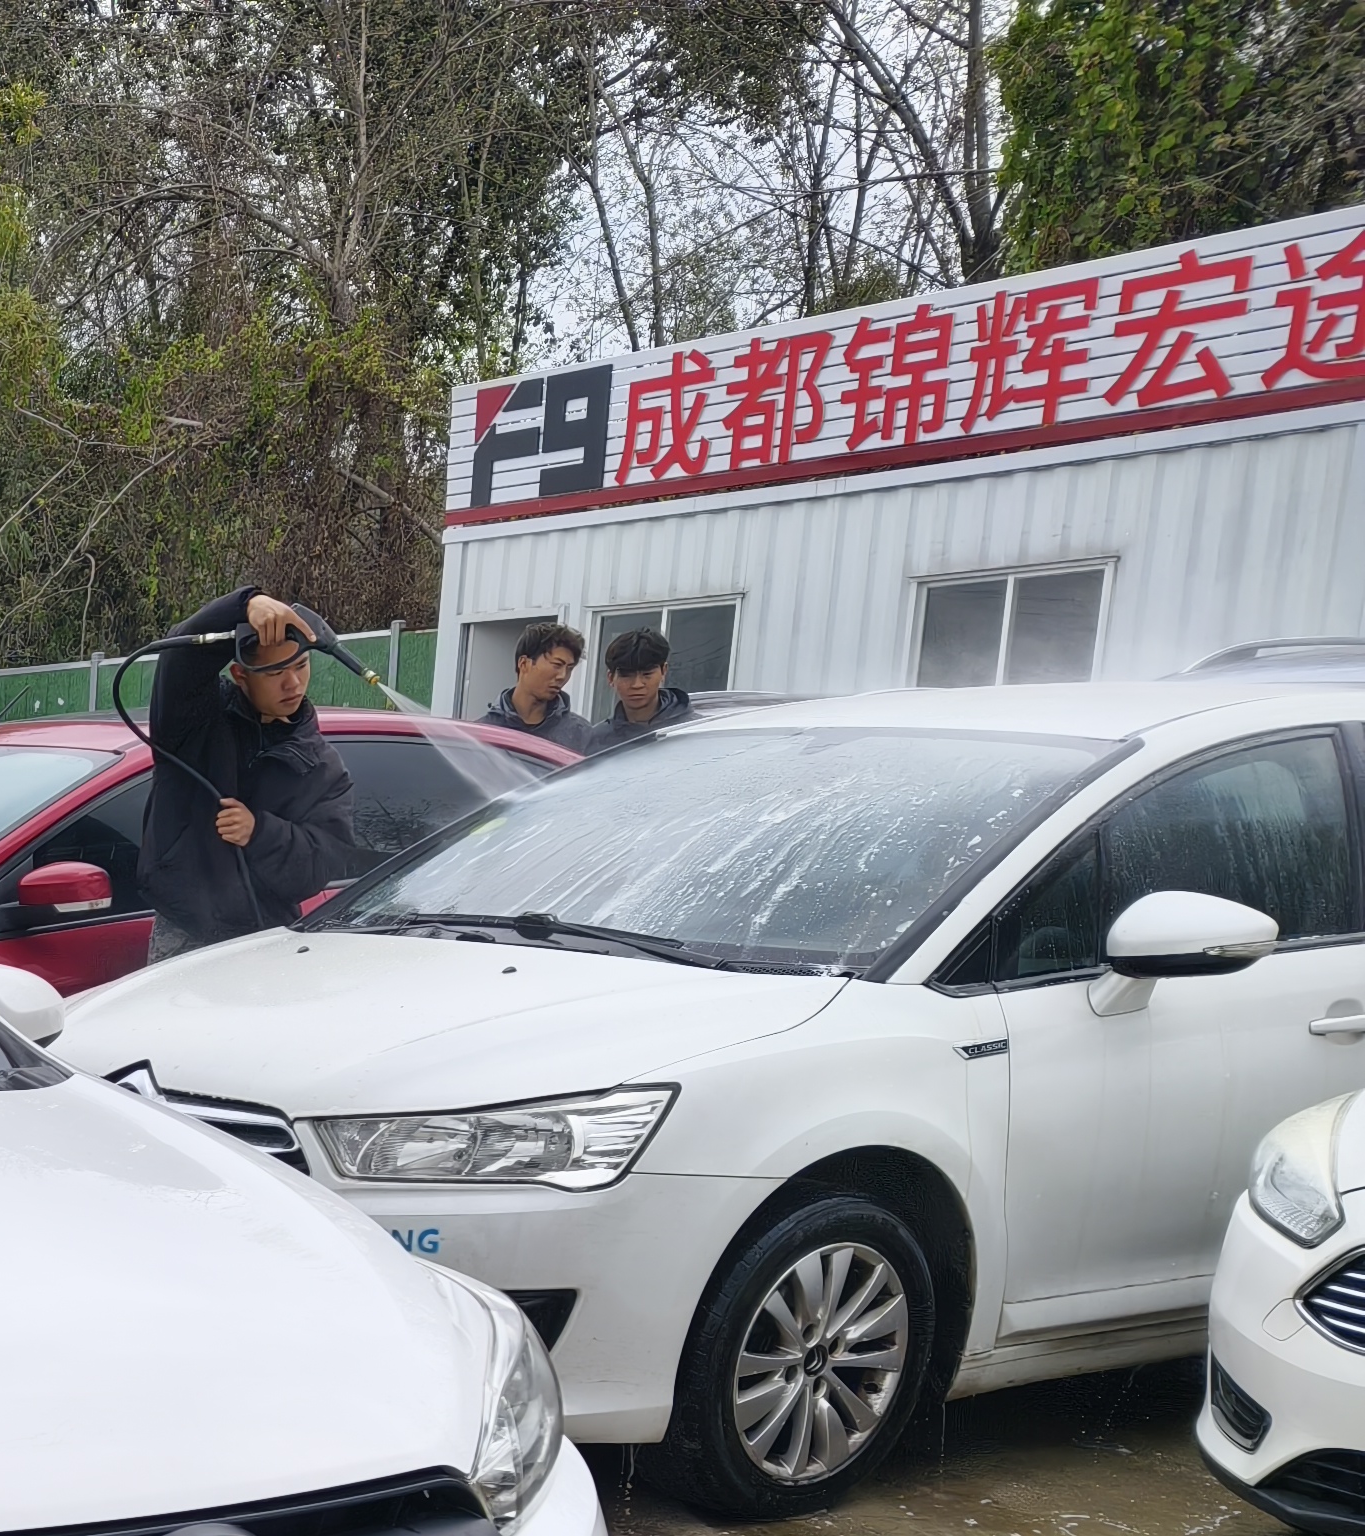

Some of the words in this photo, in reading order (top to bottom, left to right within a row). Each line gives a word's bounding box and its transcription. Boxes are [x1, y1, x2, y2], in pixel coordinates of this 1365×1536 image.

[615, 229, 1365, 486] 成都锦辉宏途
[968, 1041, 1007, 1054] CLASSIC
